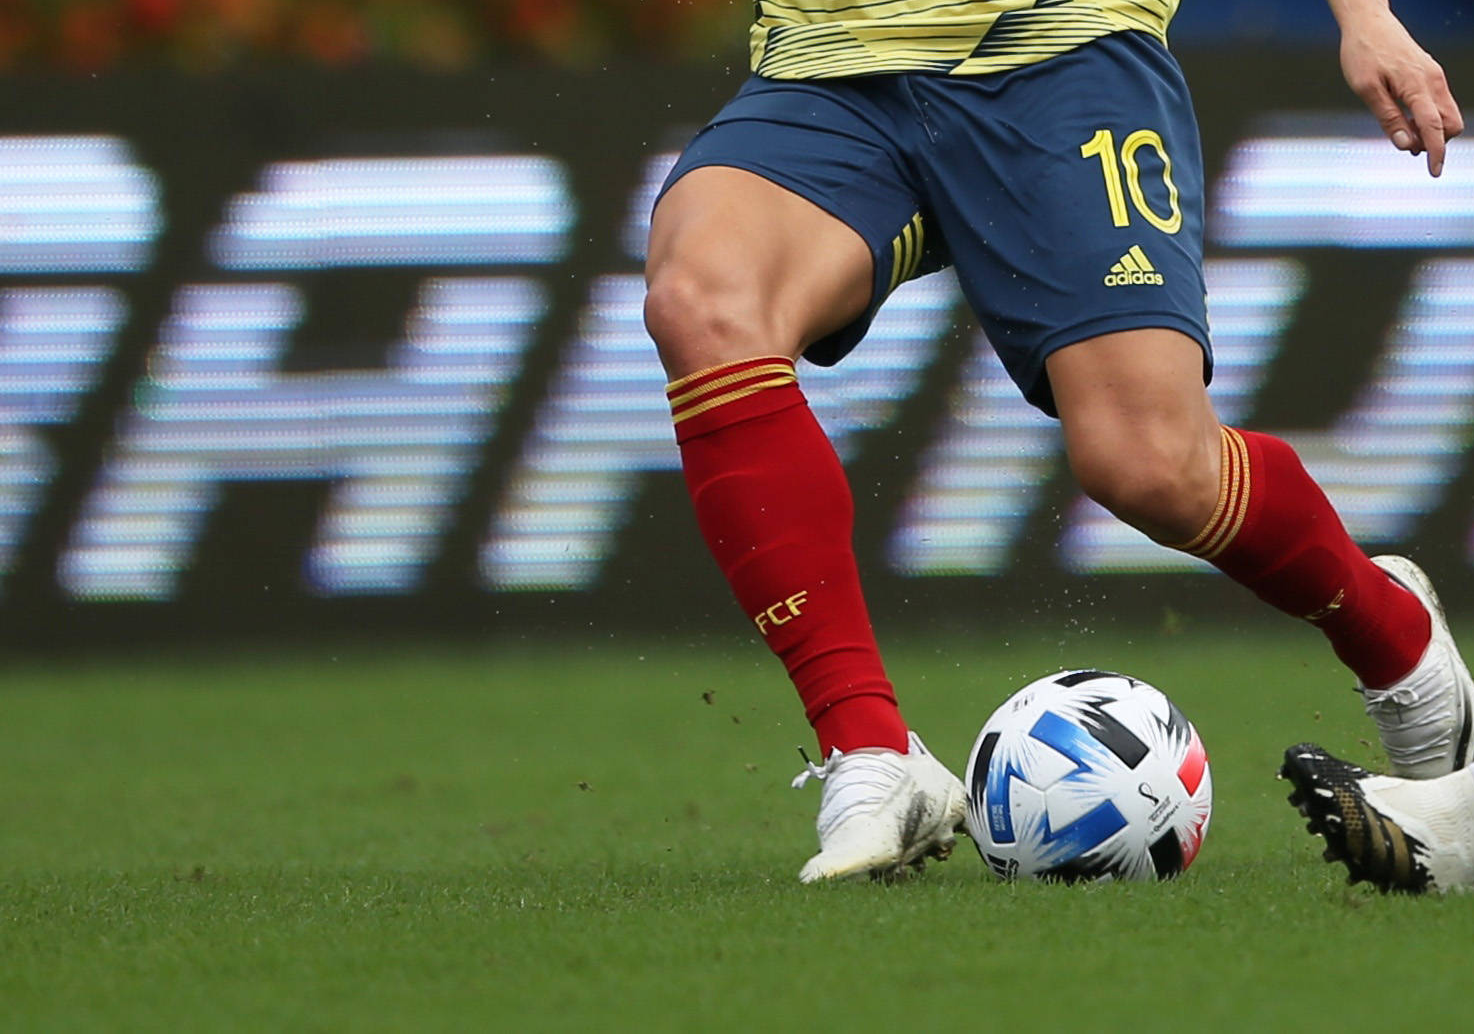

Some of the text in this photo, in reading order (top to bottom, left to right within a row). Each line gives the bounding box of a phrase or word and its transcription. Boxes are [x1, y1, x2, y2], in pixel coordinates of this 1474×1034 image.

[1080, 129, 1183, 235] 10
[1103, 270, 1165, 287] adidas
[755, 590, 808, 635] FCF
